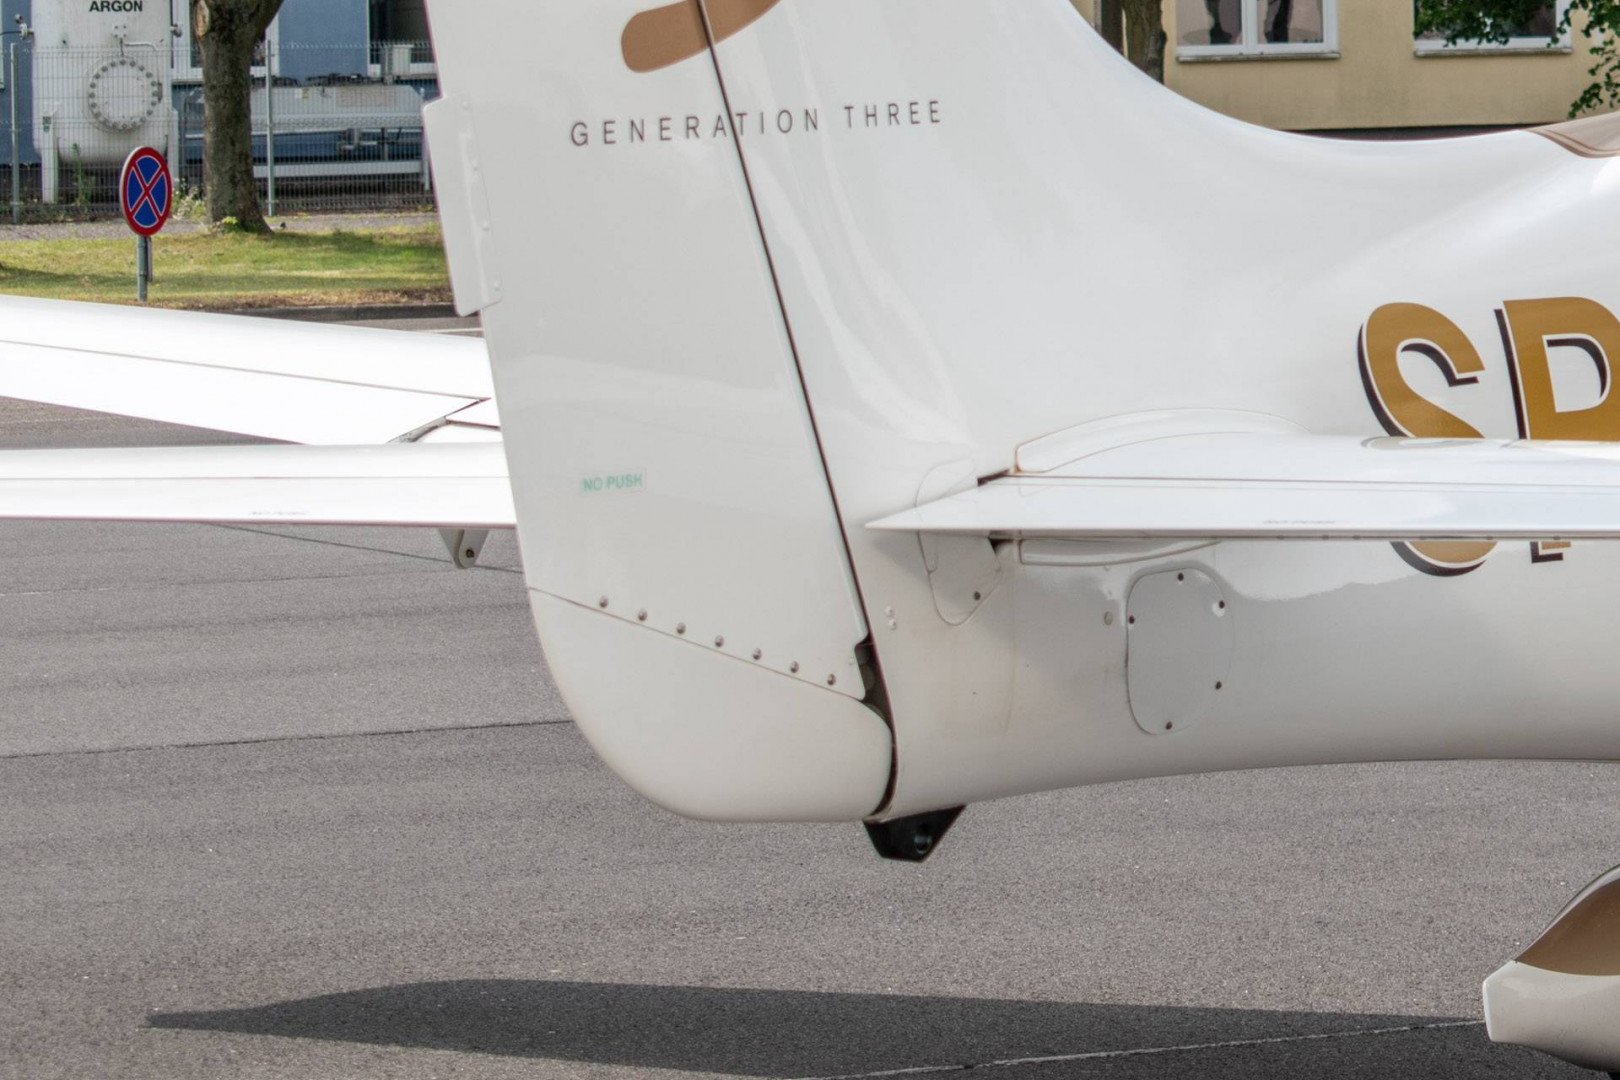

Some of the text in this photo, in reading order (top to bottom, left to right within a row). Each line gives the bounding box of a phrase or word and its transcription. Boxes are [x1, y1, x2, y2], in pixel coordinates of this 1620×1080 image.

[89, 0, 143, 12] ARGON
[569, 100, 941, 147] GENERATION THREE
[583, 473, 643, 491] NO PUSH
